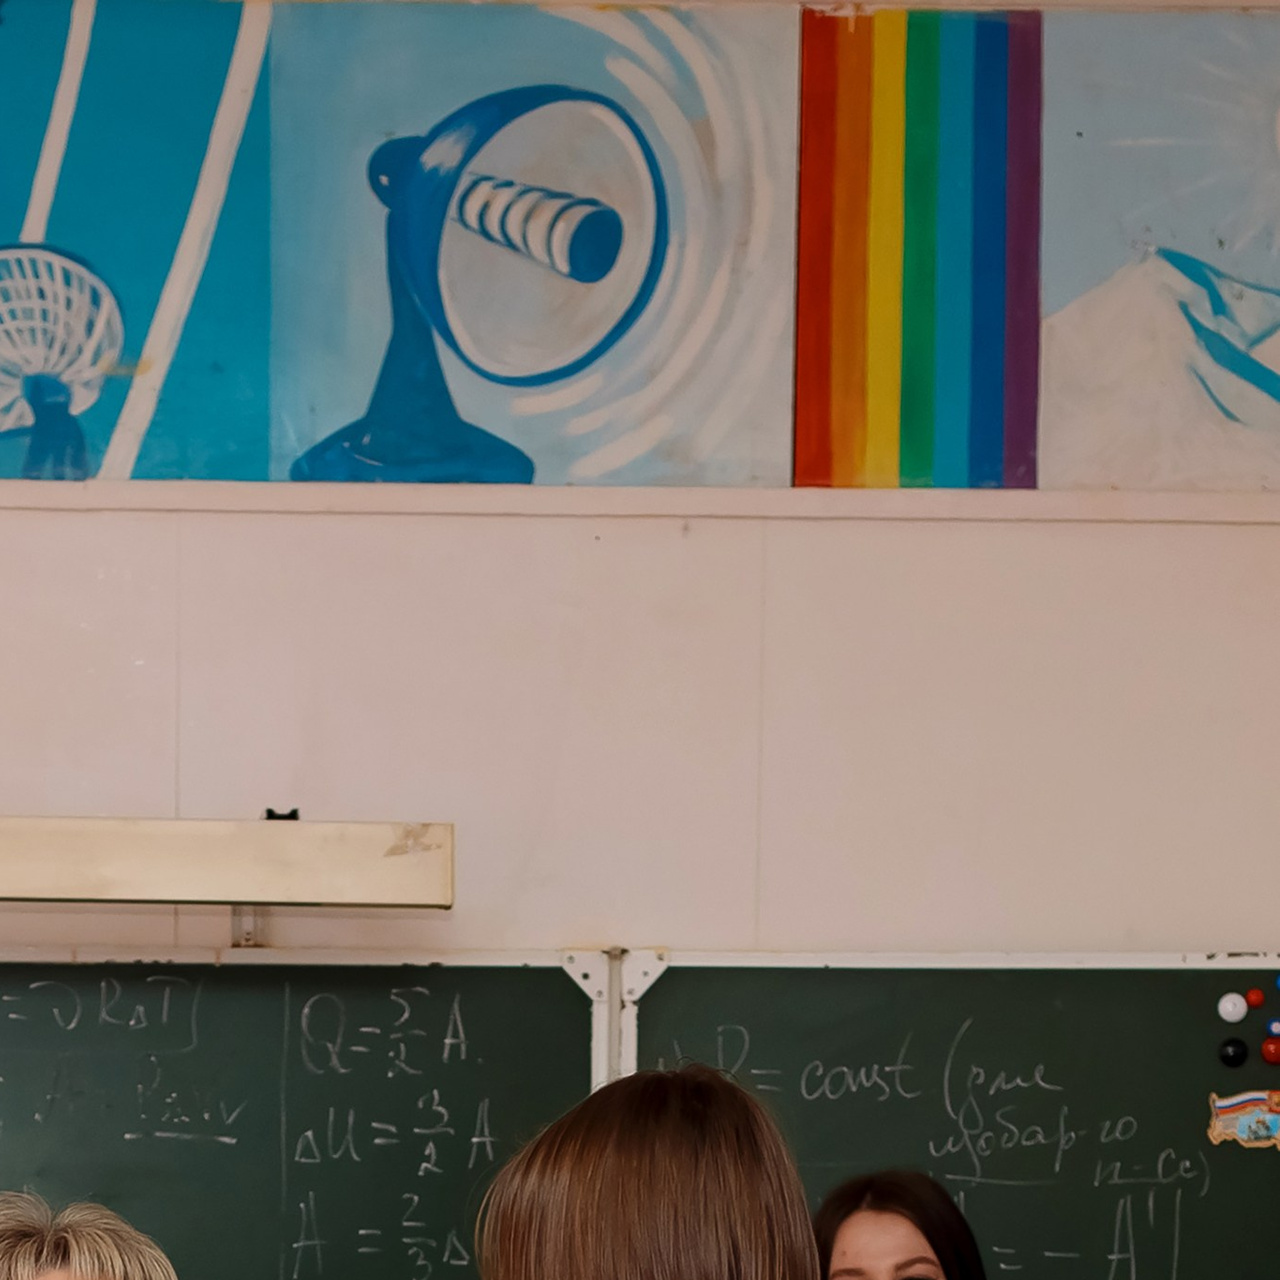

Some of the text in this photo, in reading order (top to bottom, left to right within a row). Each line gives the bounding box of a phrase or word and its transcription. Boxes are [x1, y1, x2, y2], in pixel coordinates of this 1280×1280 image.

[300, 992, 352, 1074] Q
[800, 1030, 923, 1101] const
[468, 1098, 496, 1169] A
